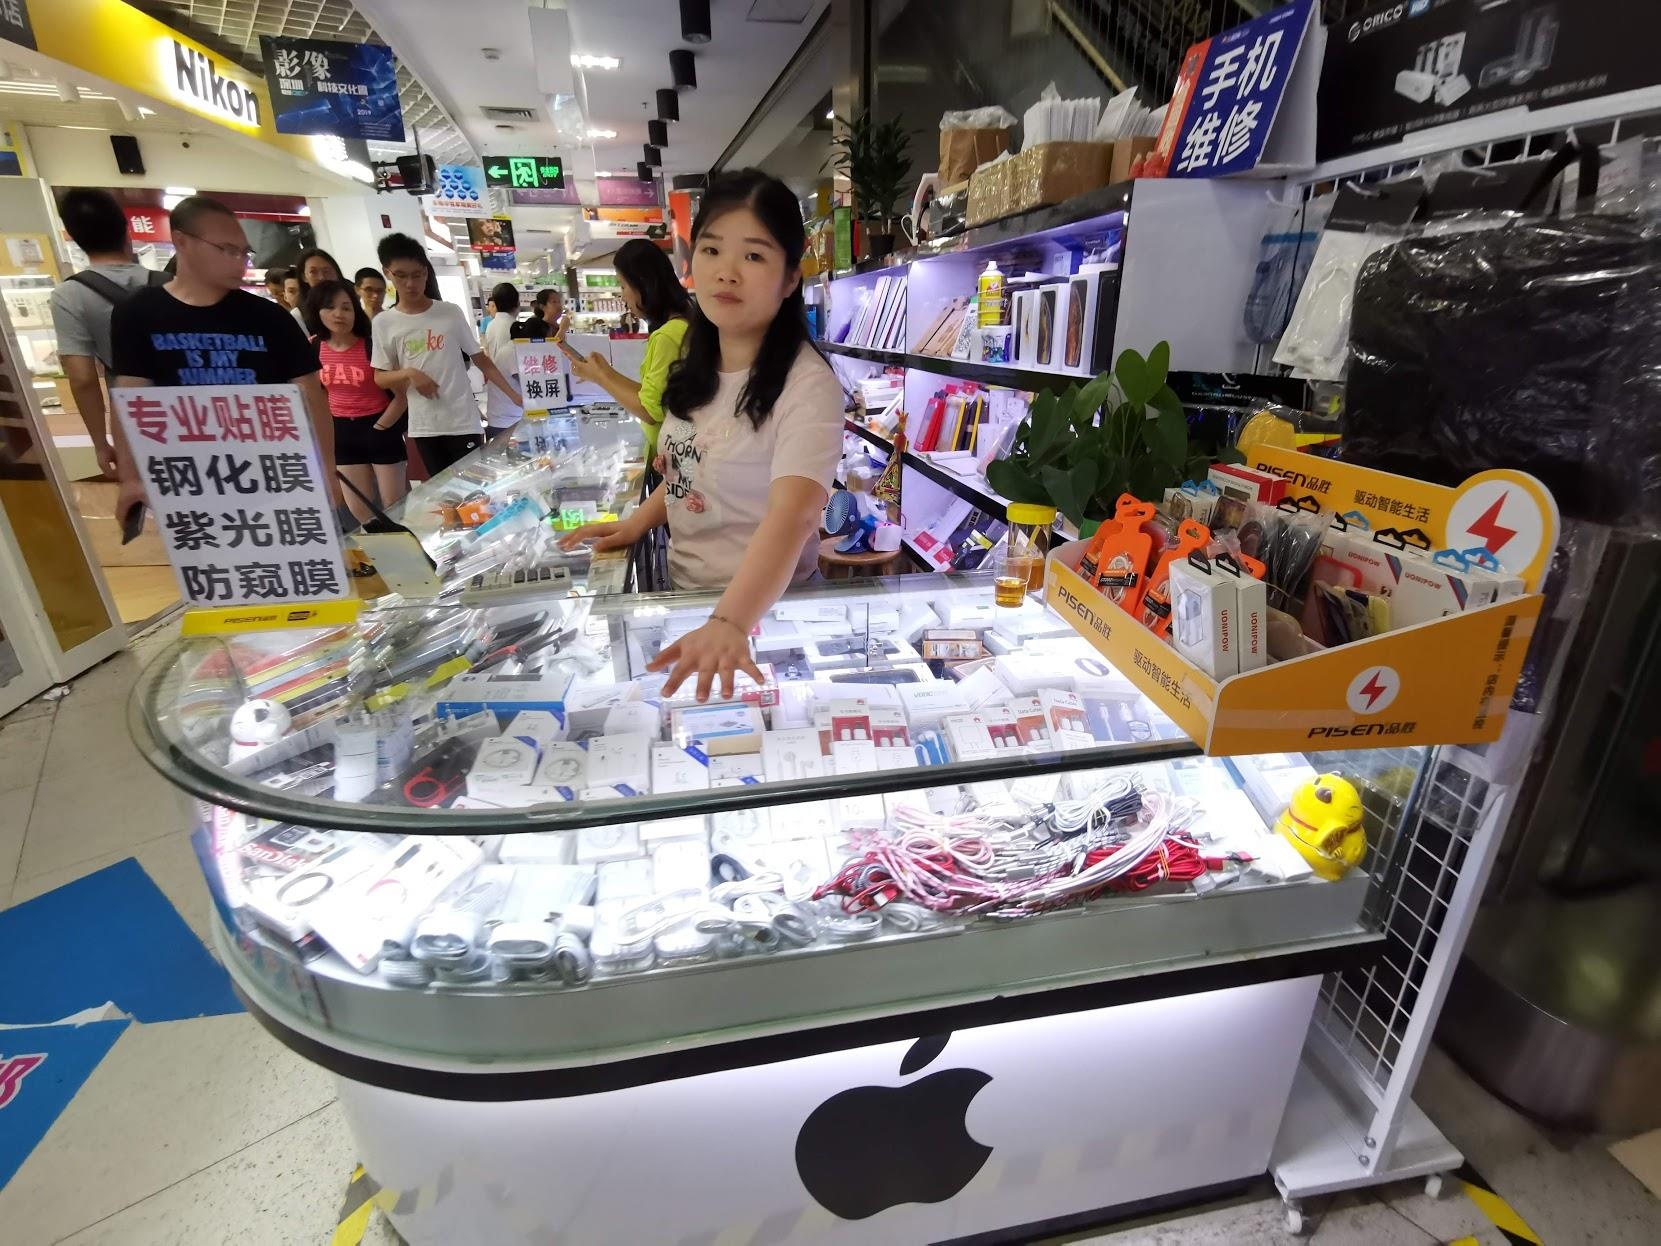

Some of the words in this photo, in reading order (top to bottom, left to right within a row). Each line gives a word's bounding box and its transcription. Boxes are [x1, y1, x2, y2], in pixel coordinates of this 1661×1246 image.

[1363, 4, 1403, 32] ORICO
[274, 49, 331, 80] 影像
[1202, 29, 1284, 110] 手机
[174, 40, 261, 126] Nikon
[1177, 100, 1263, 172] 维修
[131, 215, 155, 234] 能
[151, 332, 268, 352] BASKETBALL
[186, 350, 204, 368] IS
[210, 350, 239, 368] MY
[177, 367, 258, 385] SUMMER
[320, 363, 365, 387] GAP
[523, 354, 558, 375] 维修
[526, 379, 560, 399] 换屏
[127, 394, 300, 444] 专业贴膜
[148, 453, 315, 497] 钢化膜
[1353, 489, 1431, 524] 驱动智能生活
[166, 507, 328, 550] 紫光膜
[181, 558, 340, 602] 防窥膜
[1058, 586, 1095, 626] PISEN
[1093, 616, 1112, 641] 品胜
[1221, 608, 1230, 653] UONIPOW
[1250, 611, 1258, 655] UONIPOW
[1307, 723, 1385, 738] PISEN
